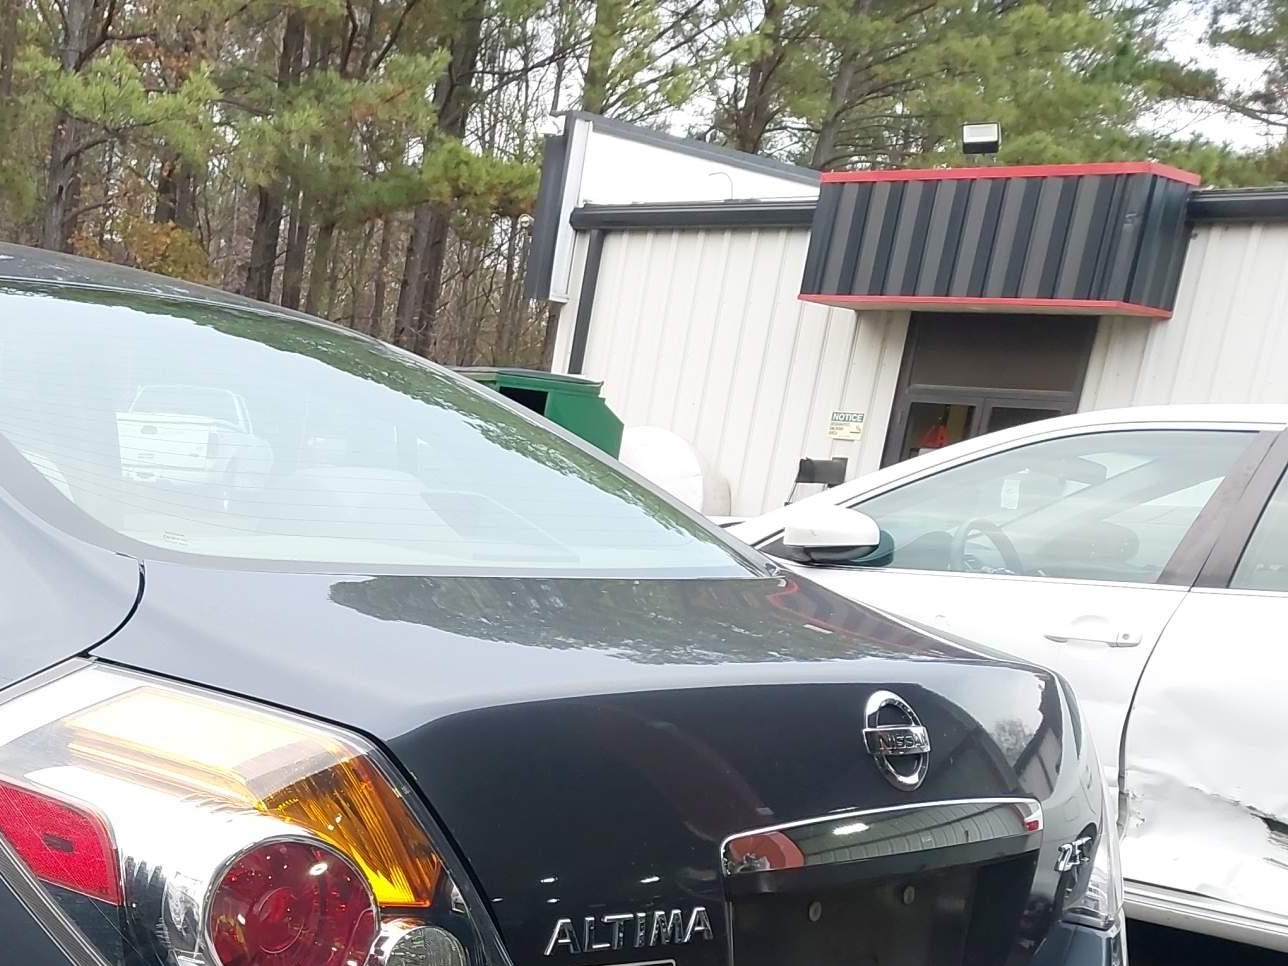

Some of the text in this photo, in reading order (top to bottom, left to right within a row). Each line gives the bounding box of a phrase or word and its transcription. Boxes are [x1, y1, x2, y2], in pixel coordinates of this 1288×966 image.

[832, 412, 864, 422] NOTICE
[879, 733, 926, 750] NISSAN
[543, 906, 714, 957] ALTIMA
